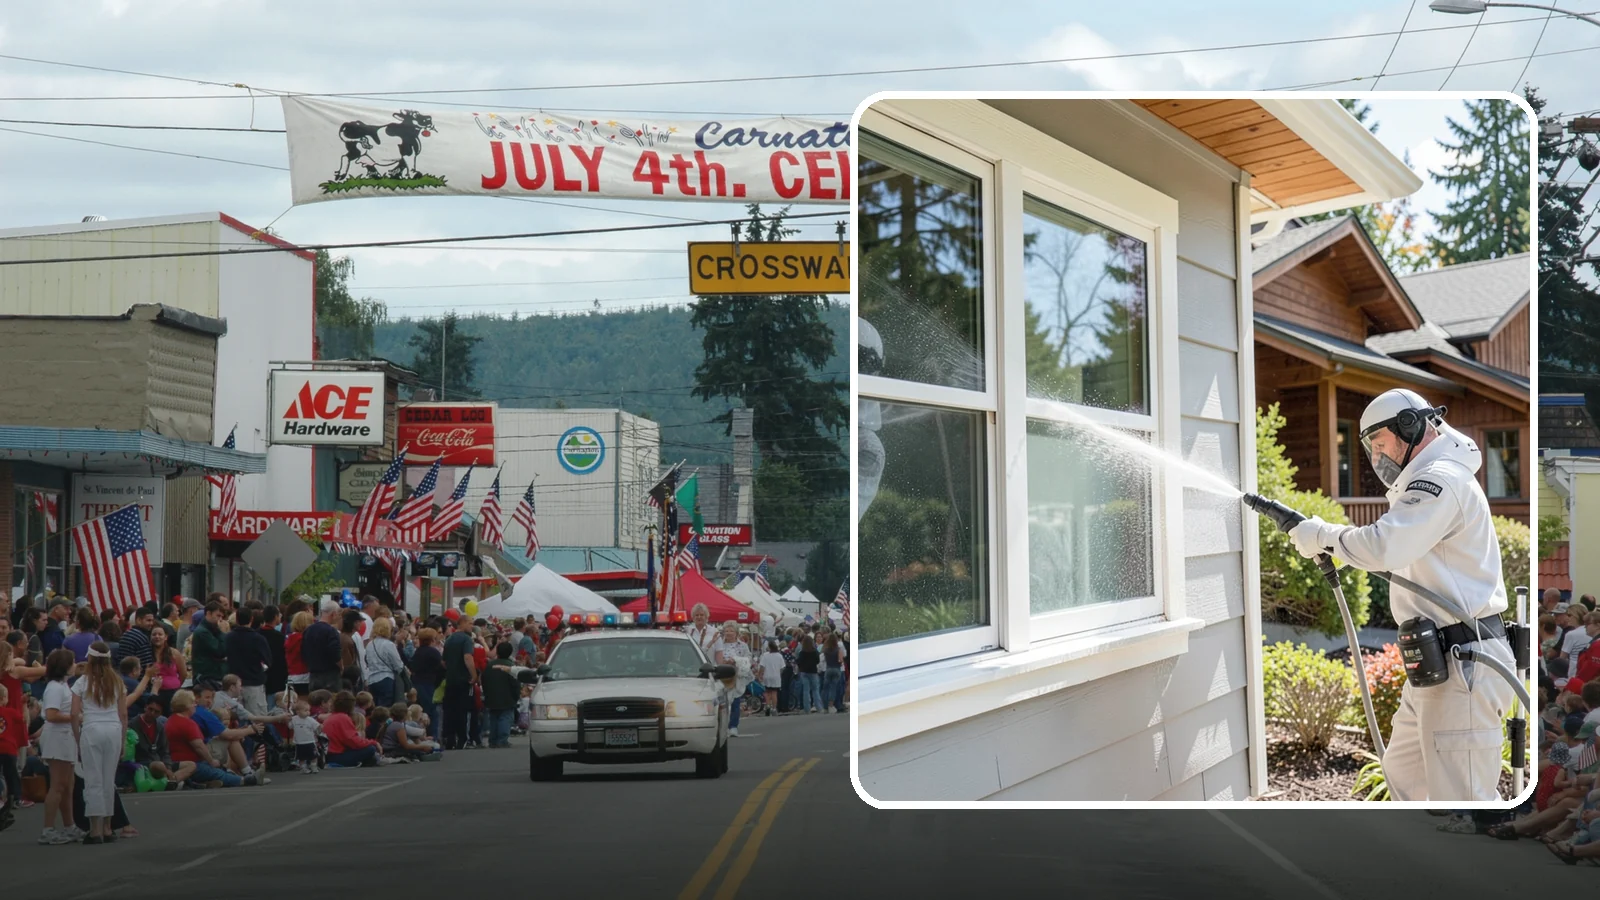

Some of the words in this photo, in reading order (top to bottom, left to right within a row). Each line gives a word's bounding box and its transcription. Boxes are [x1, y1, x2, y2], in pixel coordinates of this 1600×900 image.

[481, 141, 605, 193] JULY
[632, 149, 748, 198] 4th.
[282, 380, 374, 420] ACE
[406, 409, 453, 422] CEDAR
[283, 421, 371, 437] Hardware
[416, 427, 477, 447] Coca-Cola
[353, 467, 387, 480] Simpl
[95, 485, 124, 495] Vincent
[126, 486, 136, 495] de
[137, 485, 155, 495] Paul
[688, 526, 742, 535] CRNATION
[698, 535, 730, 544] GLASS
